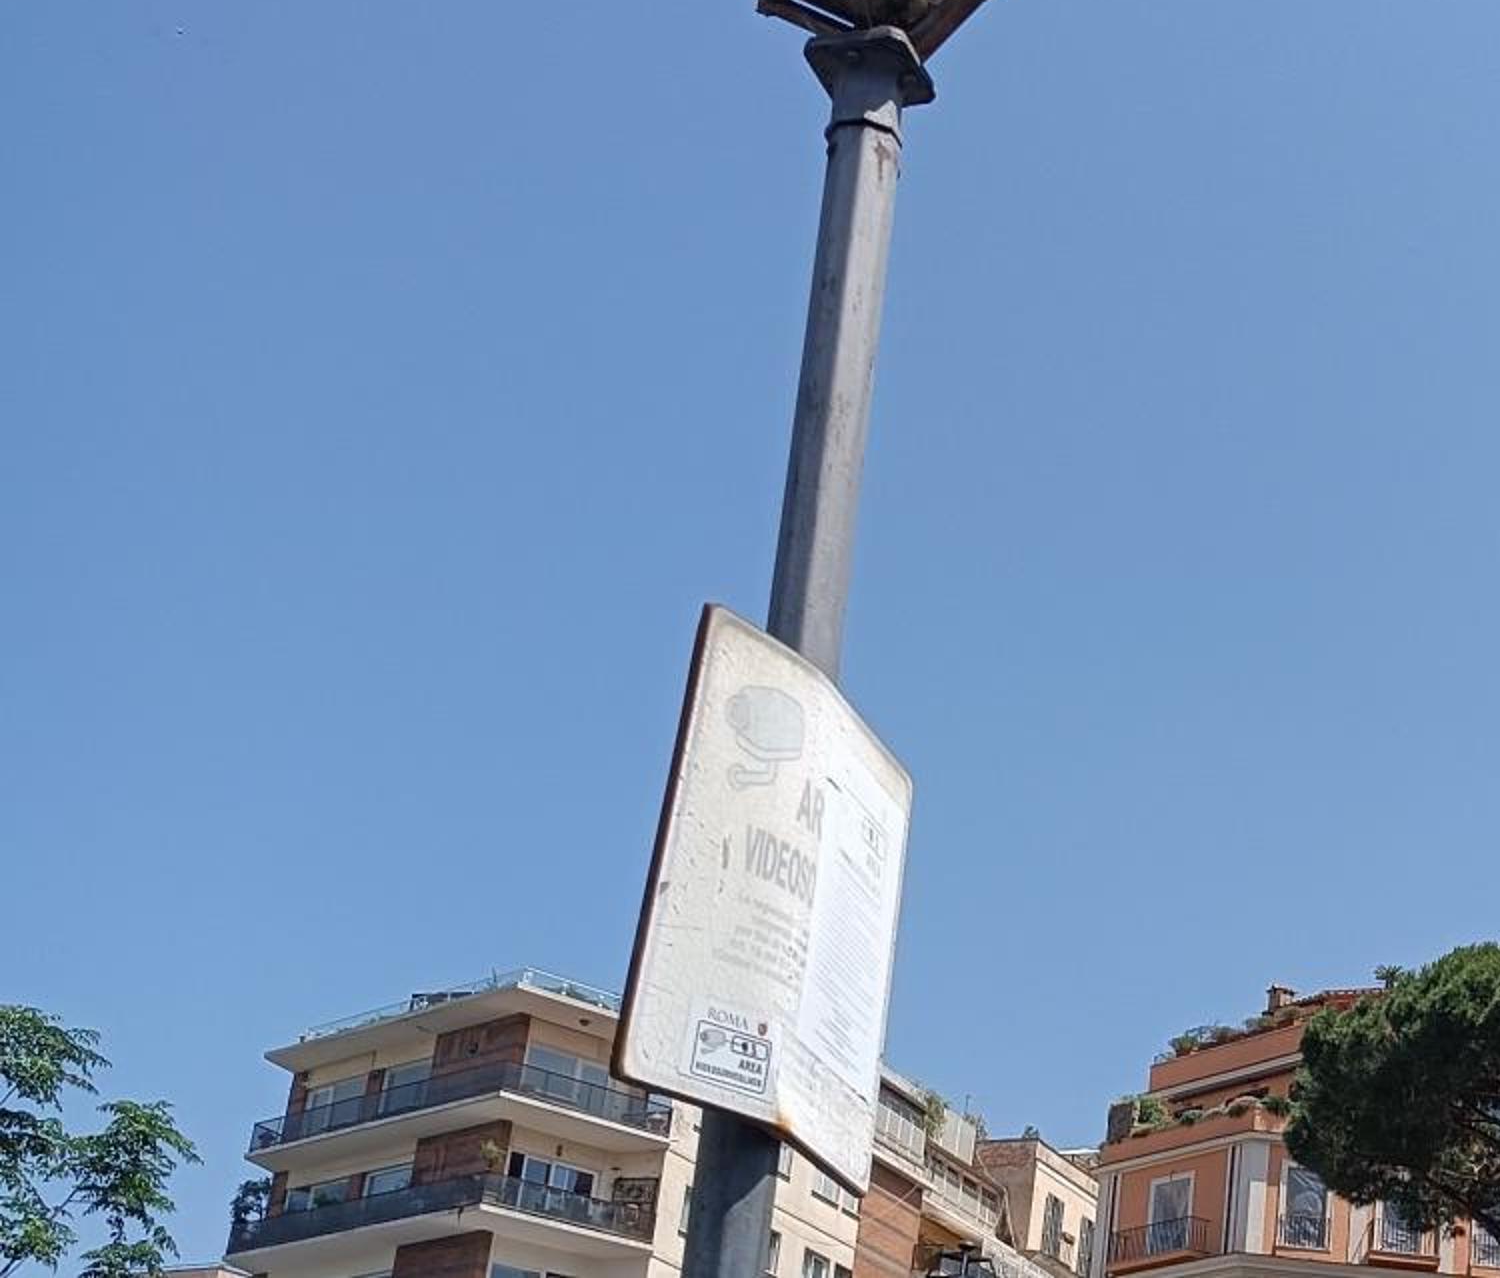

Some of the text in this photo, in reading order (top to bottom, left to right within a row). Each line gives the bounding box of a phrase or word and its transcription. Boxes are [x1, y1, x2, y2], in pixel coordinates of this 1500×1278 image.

[796, 777, 825, 842] AR
[707, 1006, 749, 1032] ROMA
[738, 1058, 762, 1076] AREA
